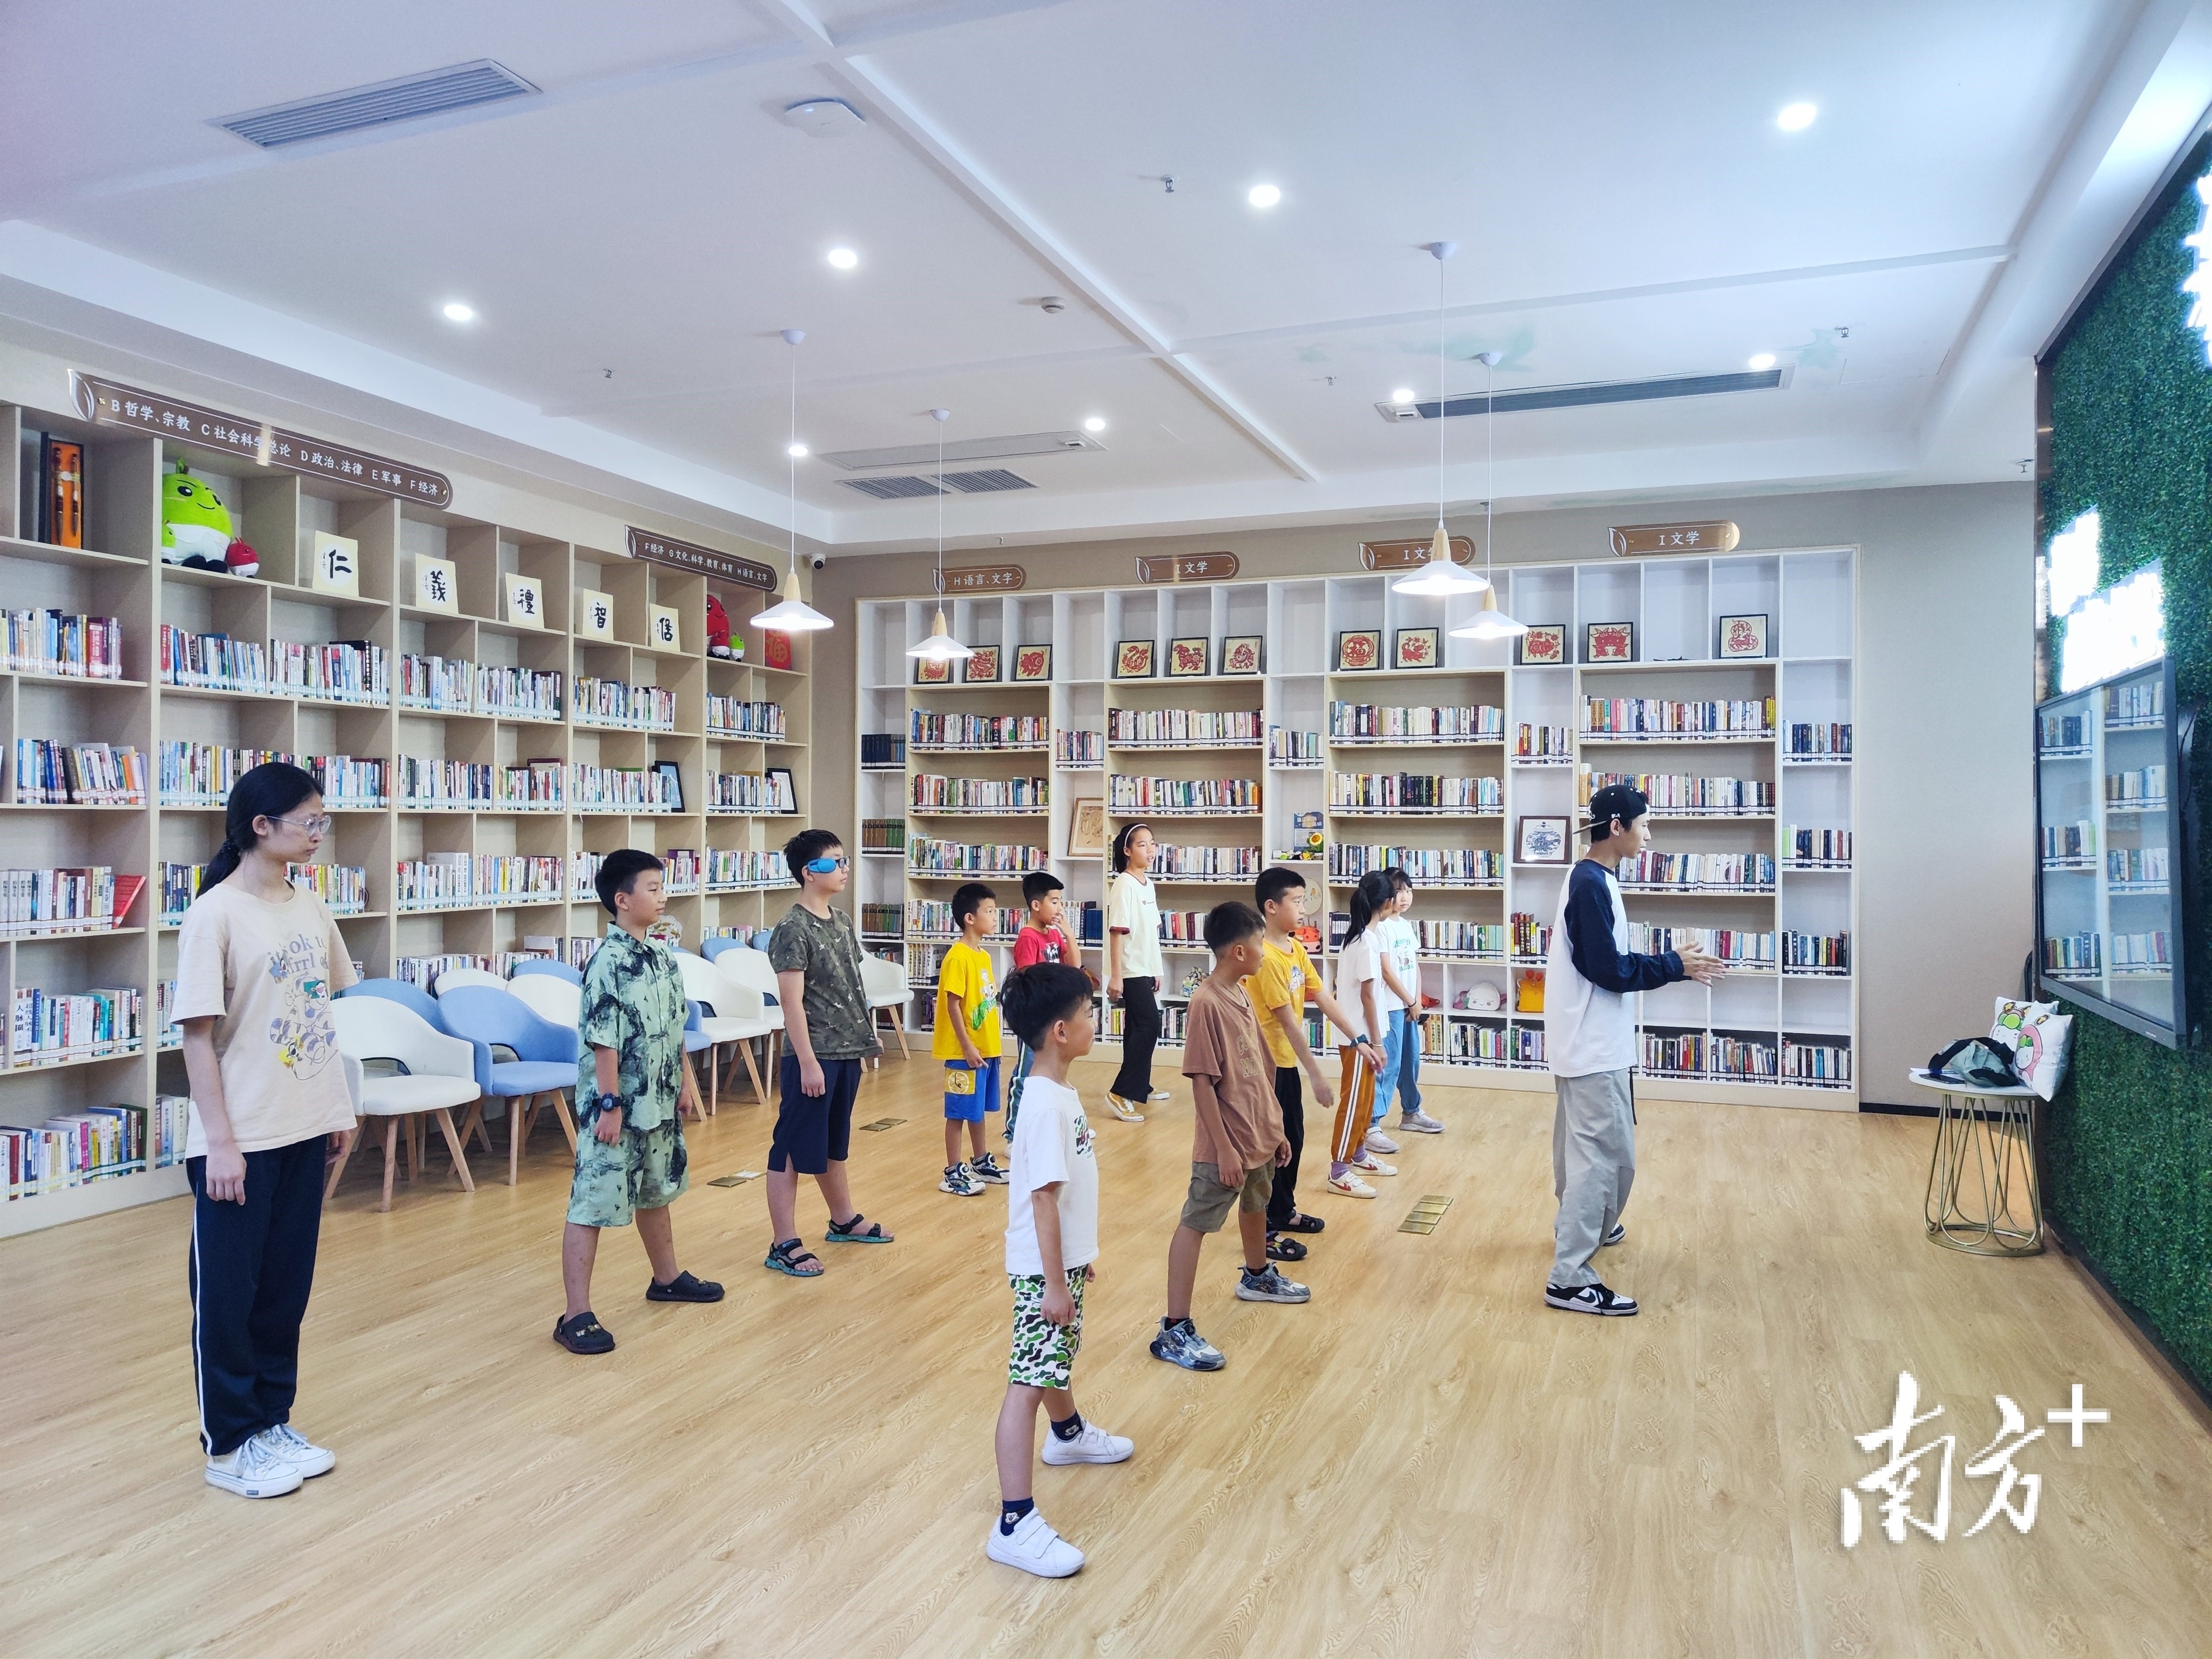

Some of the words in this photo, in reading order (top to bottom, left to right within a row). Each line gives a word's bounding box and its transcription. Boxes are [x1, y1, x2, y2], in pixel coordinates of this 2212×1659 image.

[111, 400, 120, 412] B
[125, 401, 191, 431] 哲学、宗教
[201, 423, 211, 436] C
[214, 425, 291, 457] 社会科学总论
[300, 449, 309, 462] D
[312, 452, 363, 476] 政治、法律
[372, 468, 379, 480] E
[381, 470, 402, 487] 军事
[410, 480, 416, 489] F
[418, 481, 439, 497] 经济
[1670, 531, 1701, 546] 文学
[328, 549, 352, 579] 仁
[645, 543, 649, 551] F
[650, 544, 664, 556] 经济
[676, 550, 733, 574] 文化、科学、教育、体育
[743, 569, 767, 583] 语言、文字
[1184, 561, 1208, 574] 文学
[954, 576, 961, 586] H
[963, 572, 1013, 585] 语言、文字
[594, 602, 606, 628] 智
[659, 617, 673, 642] 信
[289, 933, 314, 954] ok
